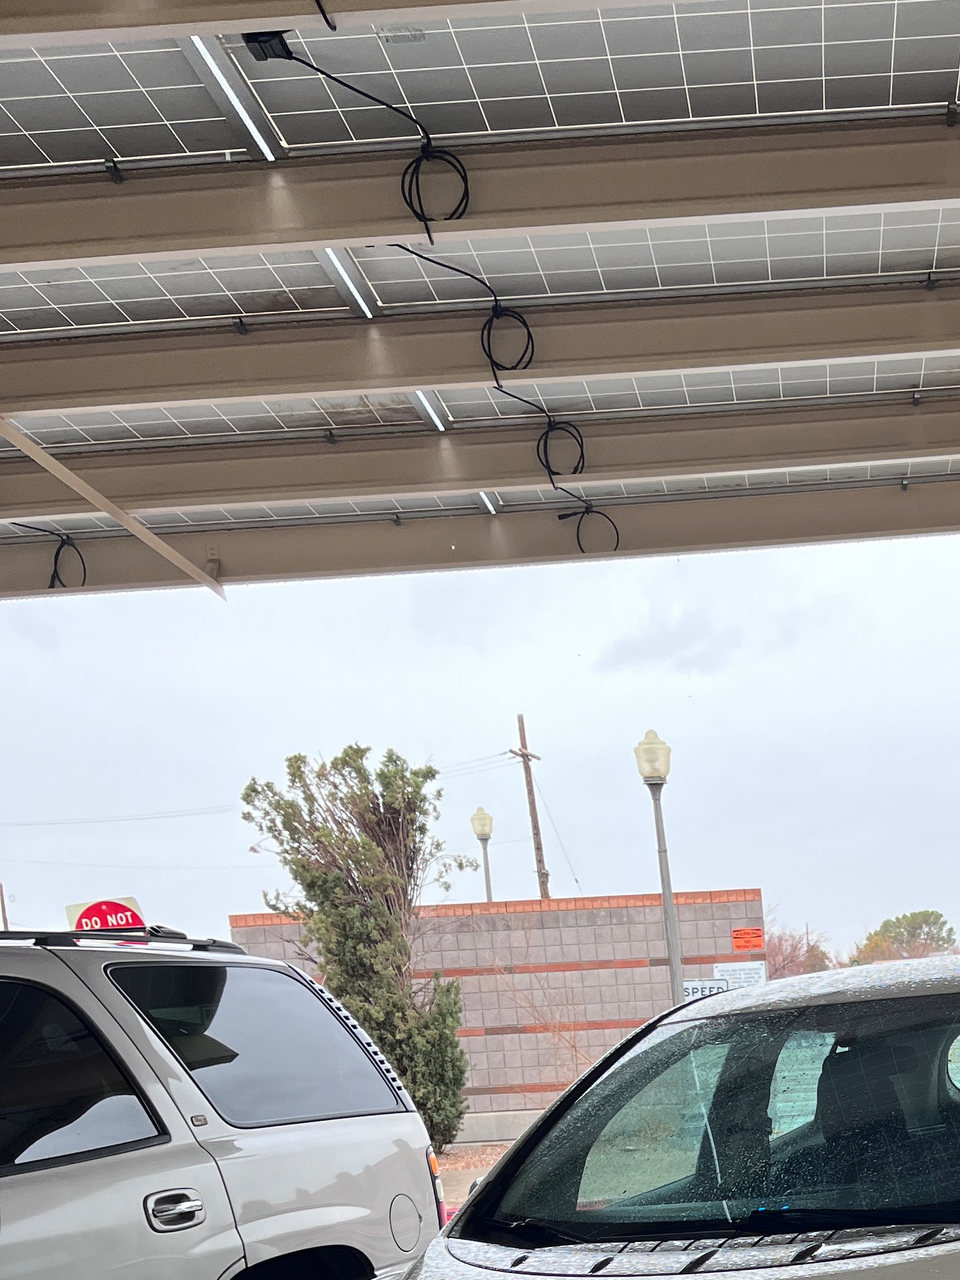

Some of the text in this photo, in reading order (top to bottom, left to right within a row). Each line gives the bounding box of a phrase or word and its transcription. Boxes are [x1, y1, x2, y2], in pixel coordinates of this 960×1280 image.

[81, 912, 133, 930] DO NOT
[683, 986, 724, 997] SPEED
[192, 1116, 205, 1125] LT
